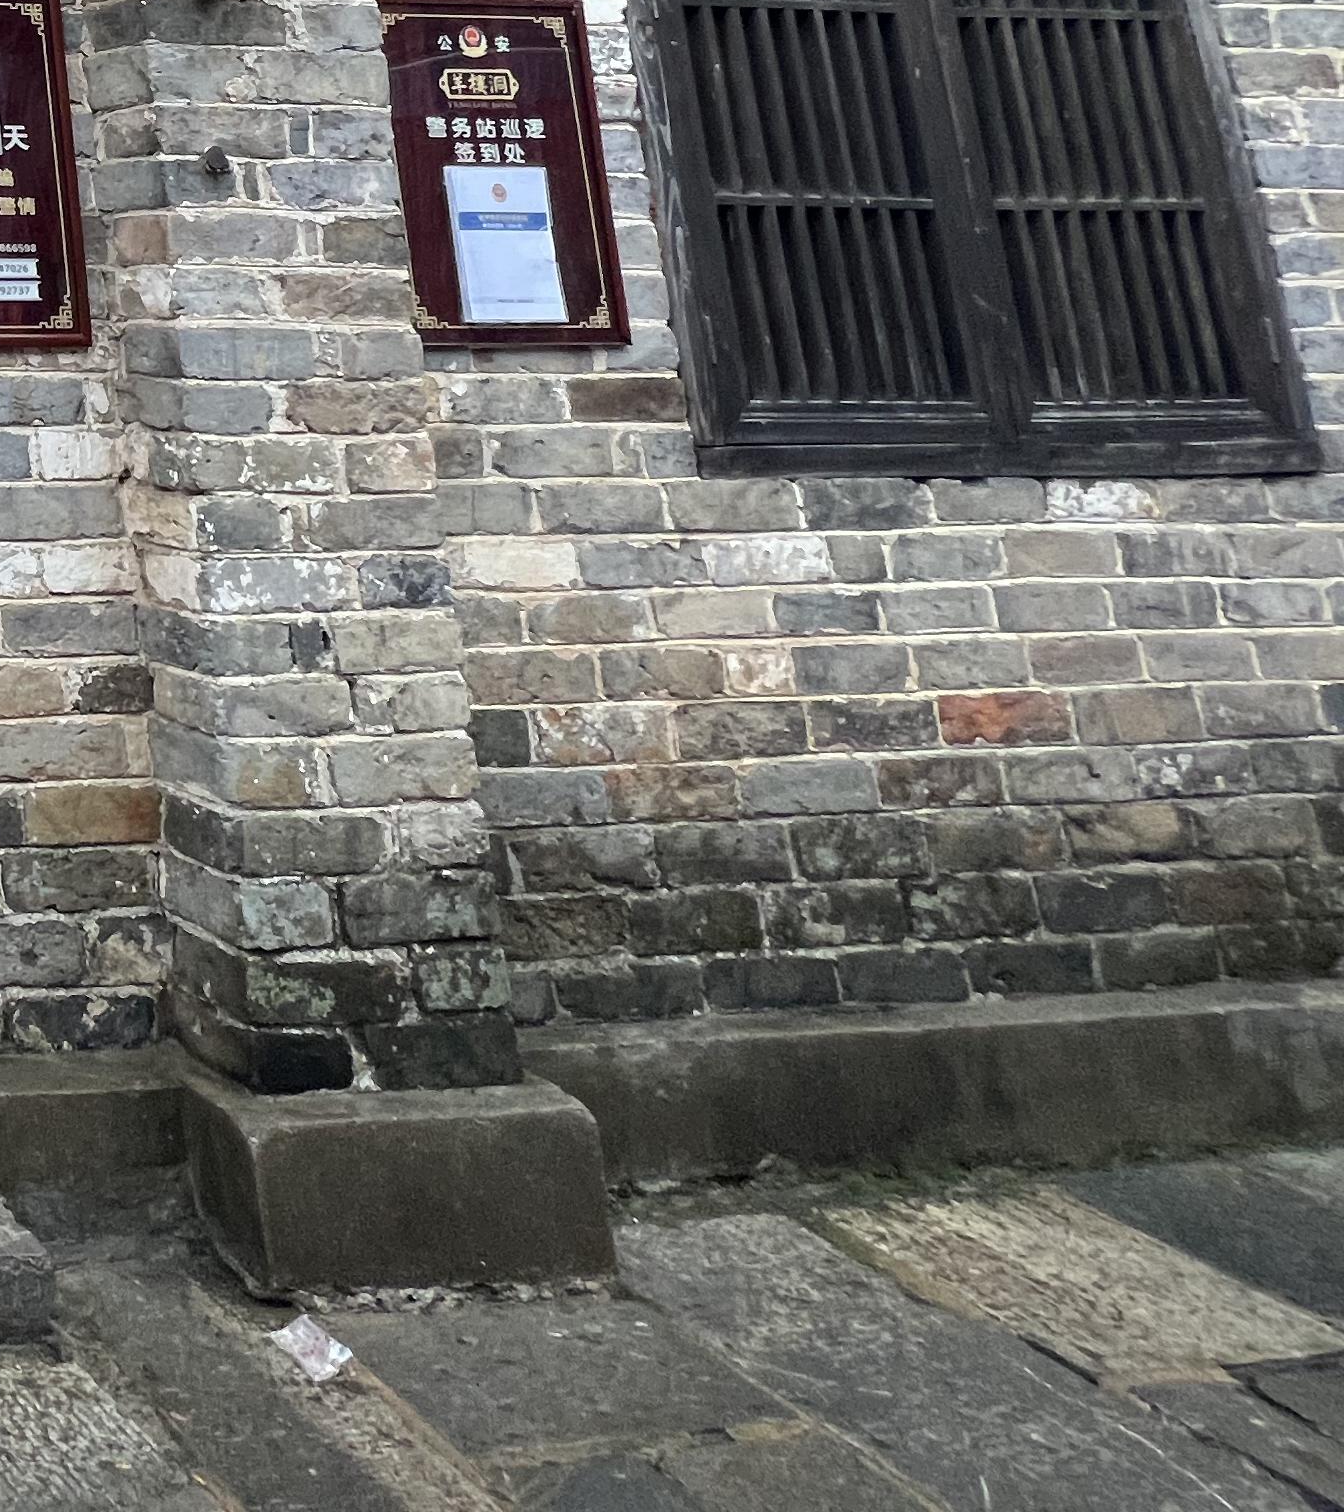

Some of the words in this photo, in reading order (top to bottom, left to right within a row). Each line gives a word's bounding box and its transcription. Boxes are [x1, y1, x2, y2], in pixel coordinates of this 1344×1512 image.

[437, 35, 452, 50] 公
[494, 35, 510, 52] 安
[426, 116, 546, 138] 警务站巡逻
[3, 125, 30, 151] 天
[454, 142, 525, 163] 签到处
